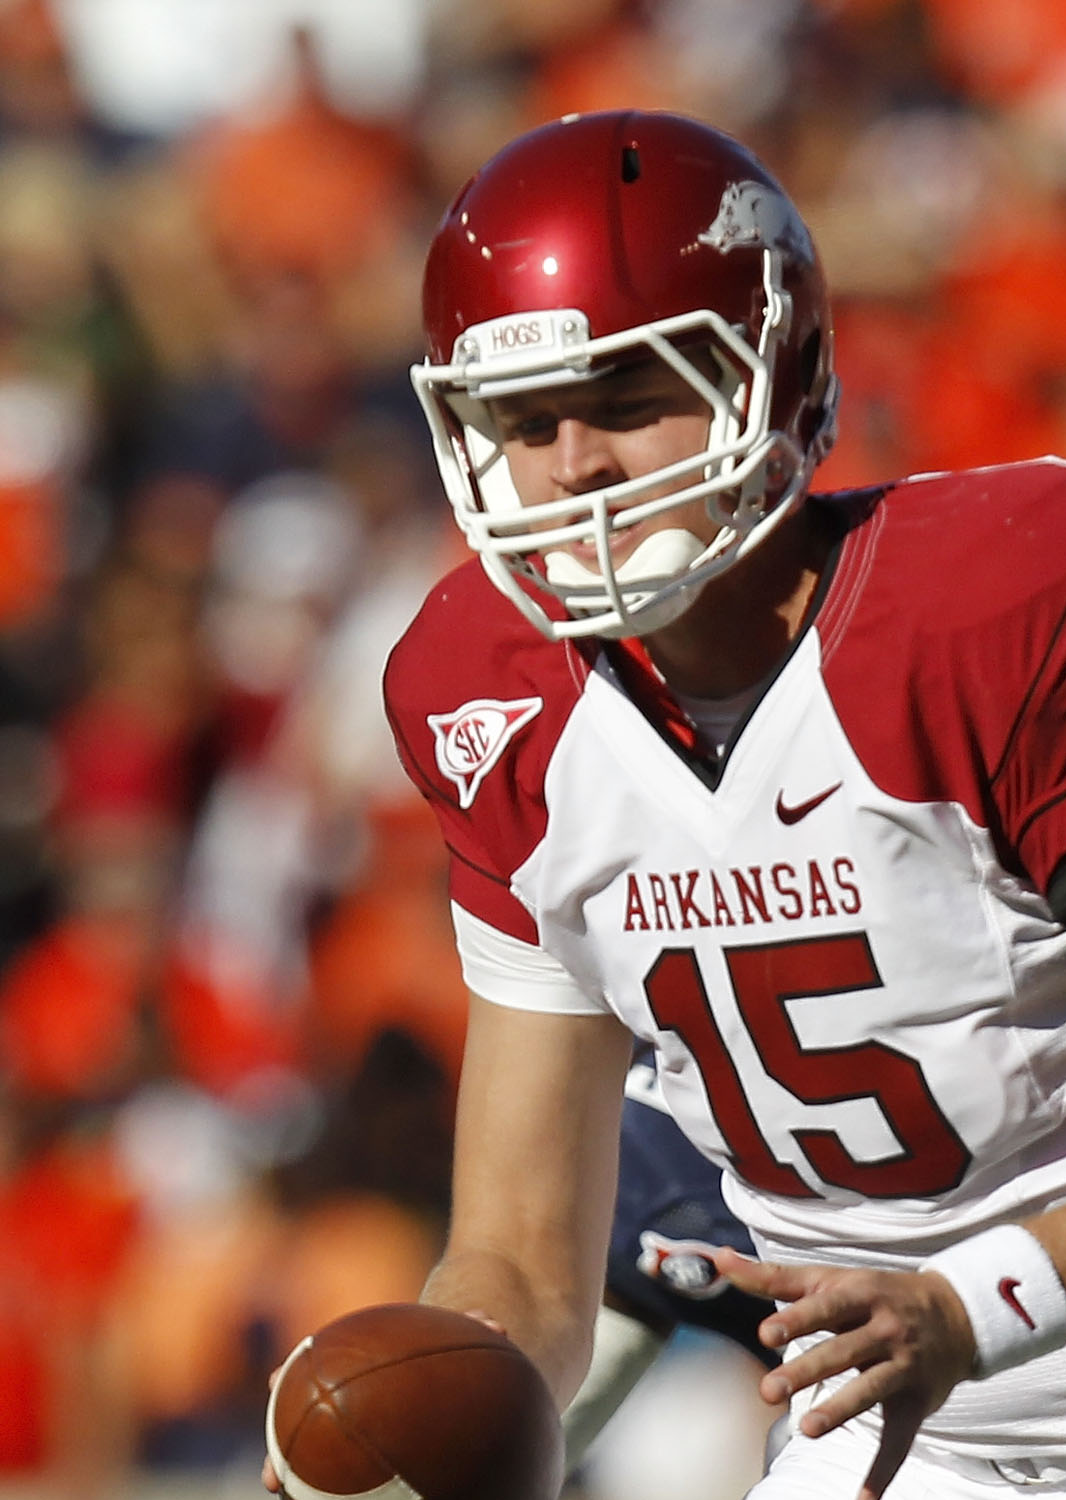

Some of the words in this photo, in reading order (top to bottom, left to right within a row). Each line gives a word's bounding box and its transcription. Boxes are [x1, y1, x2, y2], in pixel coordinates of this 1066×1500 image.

[492, 321, 542, 351] HOGS
[455, 718, 490, 763] SEC
[623, 857, 862, 932] ARKANSAS
[643, 929, 973, 1200] 15
